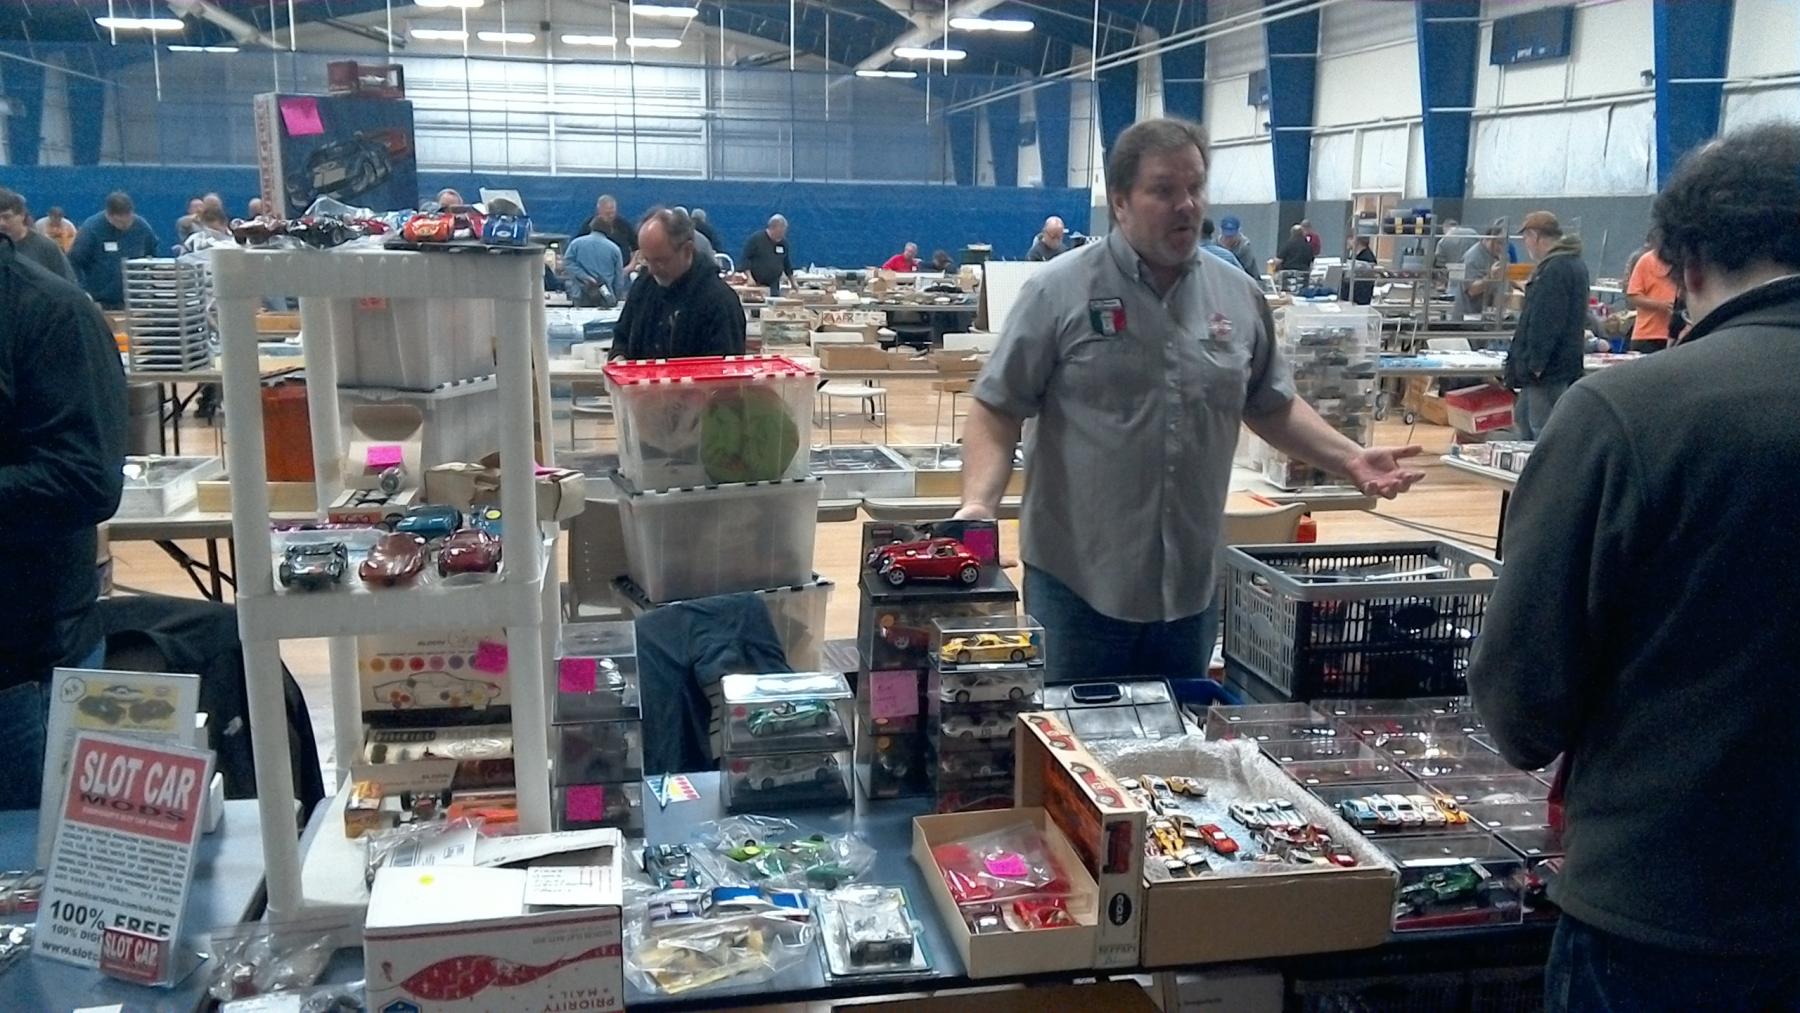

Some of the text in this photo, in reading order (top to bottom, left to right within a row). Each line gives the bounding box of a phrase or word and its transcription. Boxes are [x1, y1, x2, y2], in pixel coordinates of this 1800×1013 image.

[80, 750, 196, 811] SLOT CAR
[79, 792, 186, 821] MODS
[50, 900, 171, 938] 100% FREE
[52, 924, 77, 938] 100%
[42, 941, 98, 961] www.slotc
[104, 932, 159, 966] SLOT CAR
[544, 997, 615, 1012] PRIORITY
[561, 988, 597, 998] MAIL
